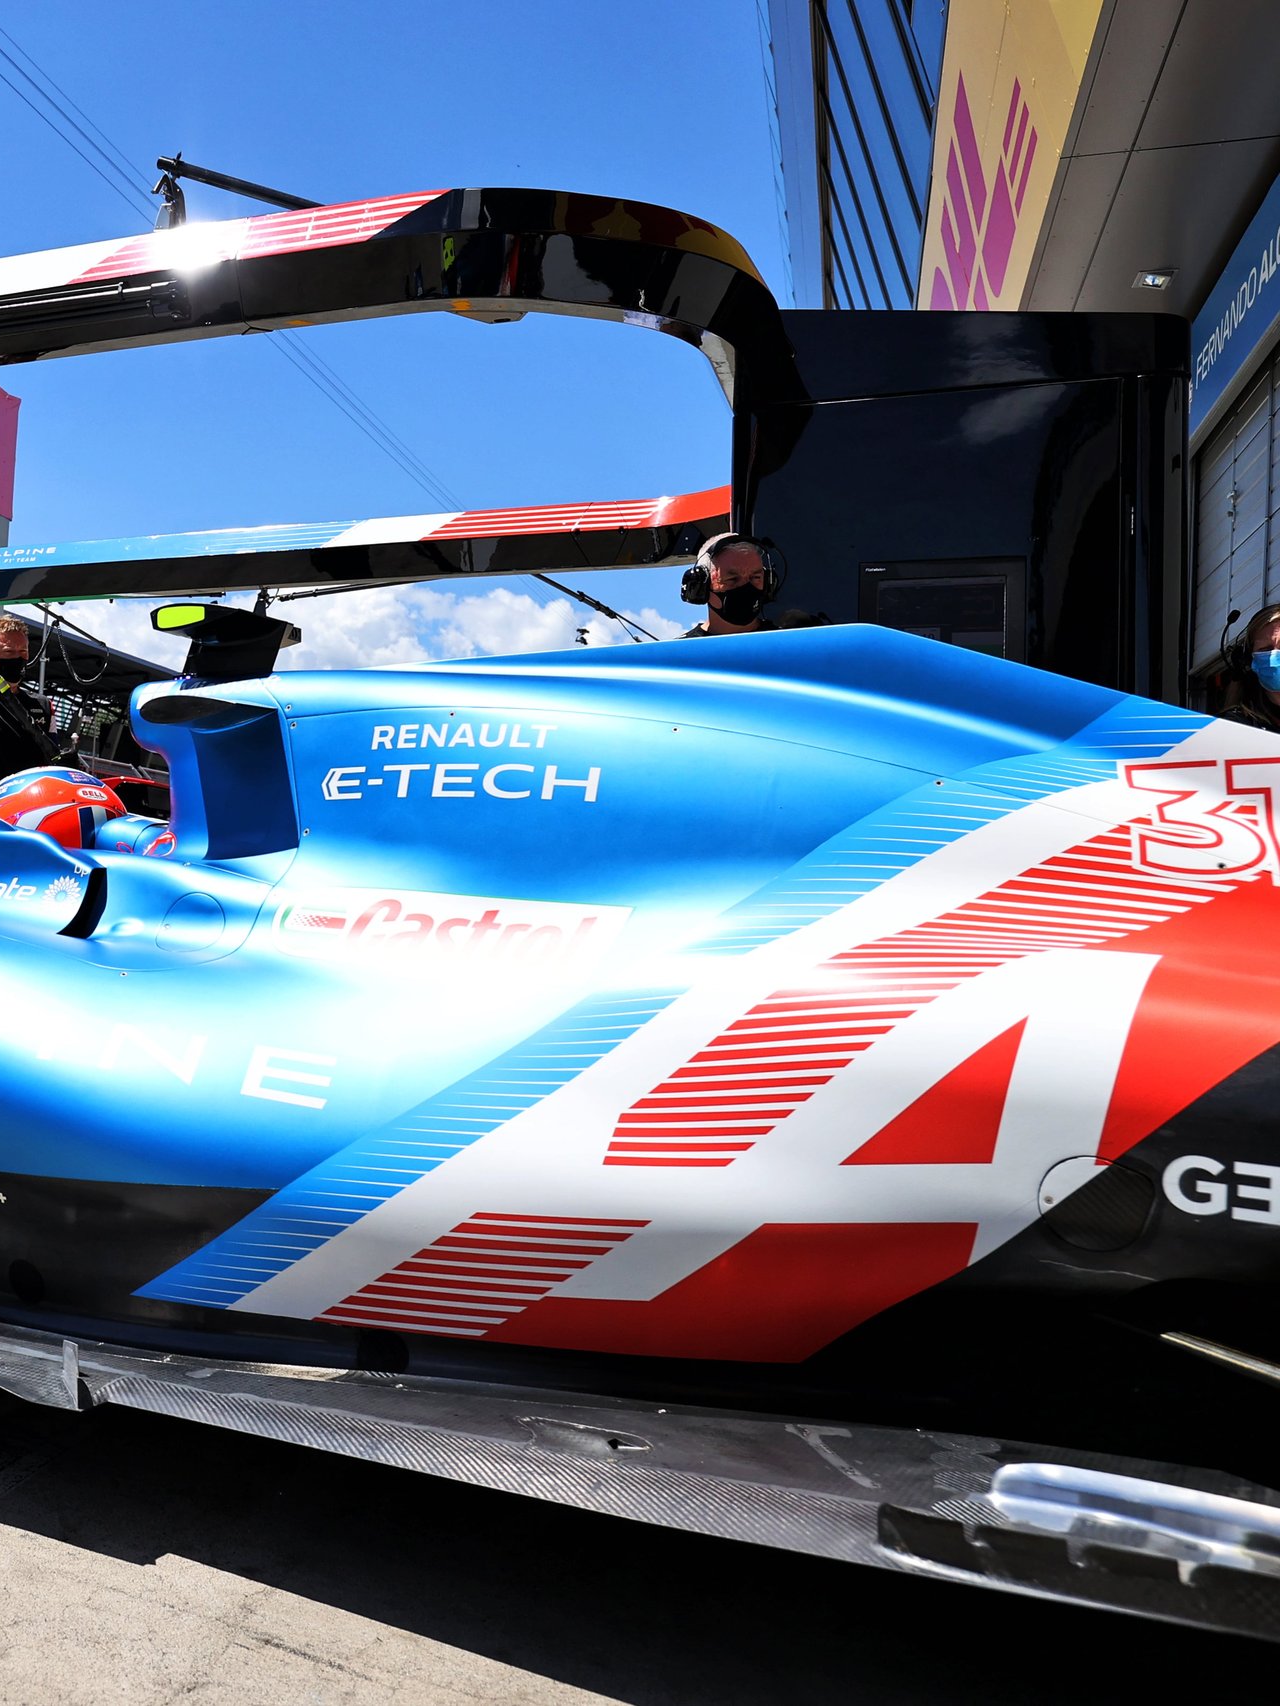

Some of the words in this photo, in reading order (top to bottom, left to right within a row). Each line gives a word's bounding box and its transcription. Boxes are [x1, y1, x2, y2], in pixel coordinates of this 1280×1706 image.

[1196, 267, 1256, 390] FERNANDO
[371, 723, 558, 750] RENAULT
[82, 790, 105, 799] BELL
[321, 763, 602, 803] E-TECH
[74, 864, 89, 877] bp
[346, 898, 598, 962] Castrol
